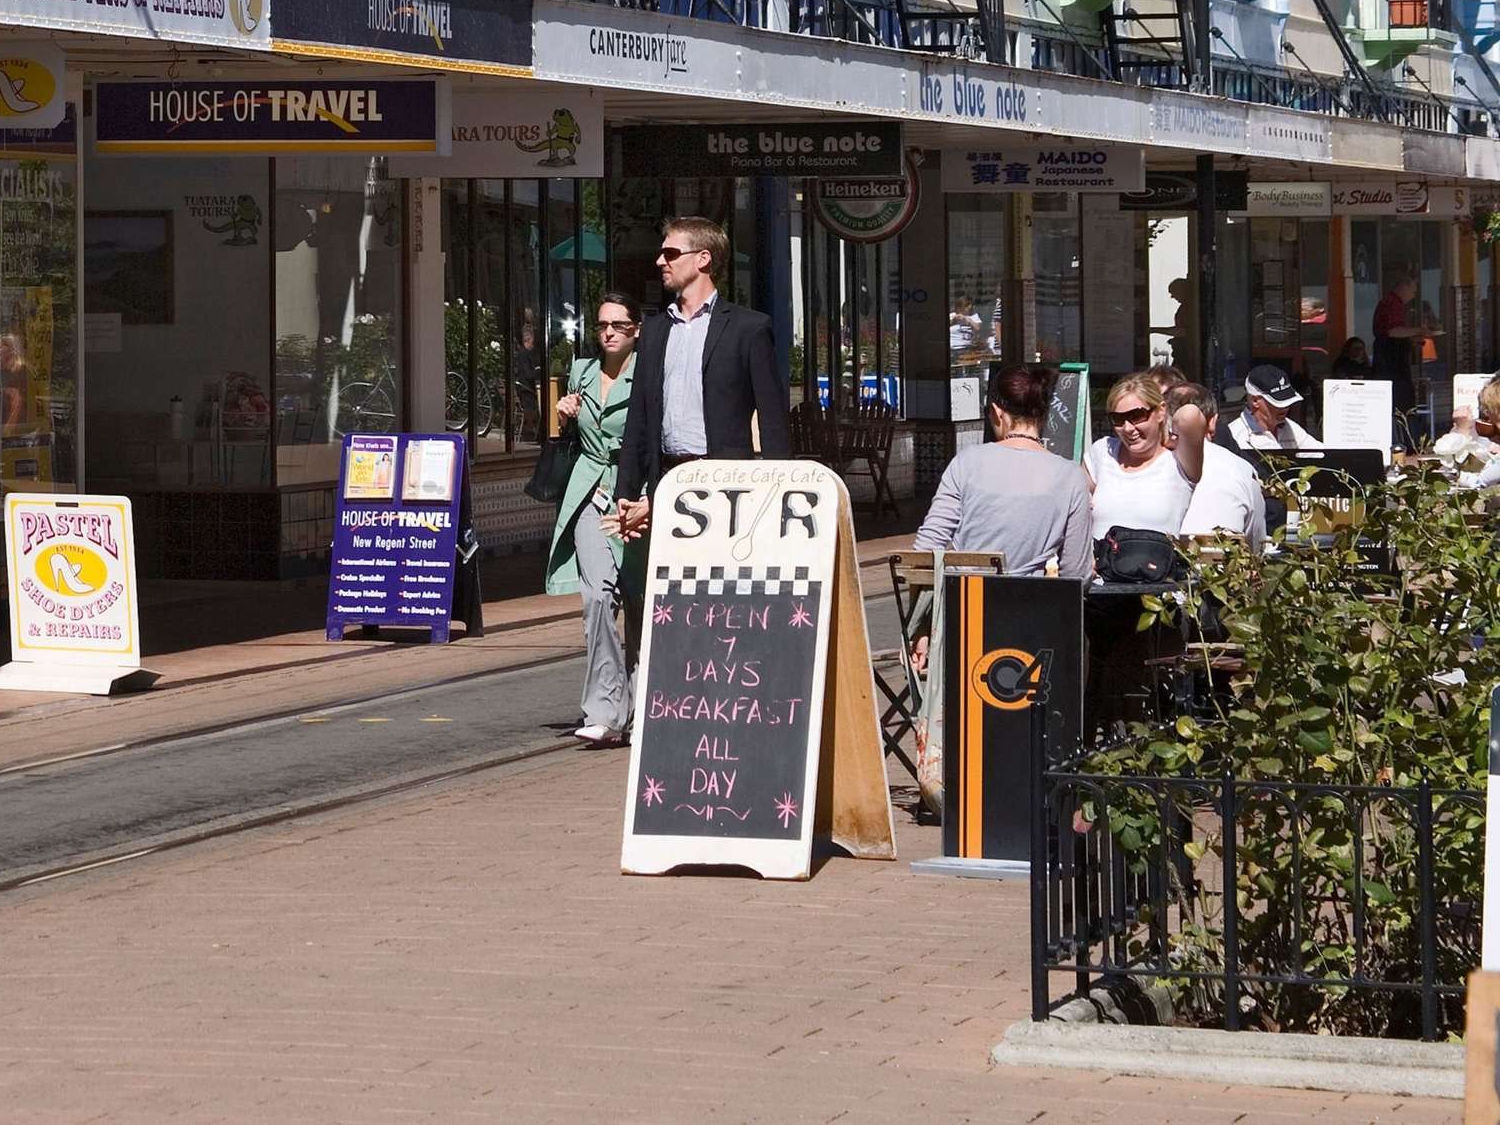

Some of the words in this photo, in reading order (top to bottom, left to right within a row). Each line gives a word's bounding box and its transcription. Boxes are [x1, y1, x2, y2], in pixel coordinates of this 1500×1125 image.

[589, 28, 664, 62] CANTERBURY
[664, 23, 688, 79] fare
[149, 91, 224, 122] HOUSE
[233, 91, 262, 122] OF
[269, 89, 383, 123] TRAVEL
[919, 70, 943, 113] the
[953, 73, 986, 117] blue
[996, 81, 1027, 122] note
[451, 126, 478, 142] ARA
[482, 124, 541, 142] TOURS
[707, 131, 749, 154] the
[758, 130, 815, 154] blue
[823, 131, 883, 153] note
[731, 155, 762, 168] Piano
[764, 156, 784, 167] Bar
[786, 156, 797, 167] &
[799, 156, 859, 167] Restaurant
[1037, 151, 1108, 166] MAIDO
[1035, 176, 1116, 187] Restaurant
[1041, 166, 1104, 176] Japanese
[825, 181, 901, 197] Heineken
[1347, 187, 1393, 206] Studio
[676, 468, 709, 484] Cafe
[713, 468, 746, 484] Cafe
[751, 468, 786, 484] Cafe
[790, 468, 825, 484] Cafe
[341, 510, 378, 527] HOUSE
[381, 511, 395, 527] OF
[397, 512, 451, 528] TRAVEL
[20, 512, 118, 560] PASTEL
[353, 535, 371, 548] New
[375, 536, 405, 551] Regent
[409, 536, 436, 549] Street
[21, 577, 67, 619] SHOE
[70, 581, 124, 621] DYERS
[686, 602, 772, 630] OPEN
[28, 623, 41, 637] &
[46, 621, 122, 640] REPAIRS
[717, 636, 736, 663] 7
[685, 658, 762, 687] DAYS
[649, 690, 803, 725] BREAKFAST
[695, 734, 740, 762] ALL
[690, 767, 738, 799] DAY
